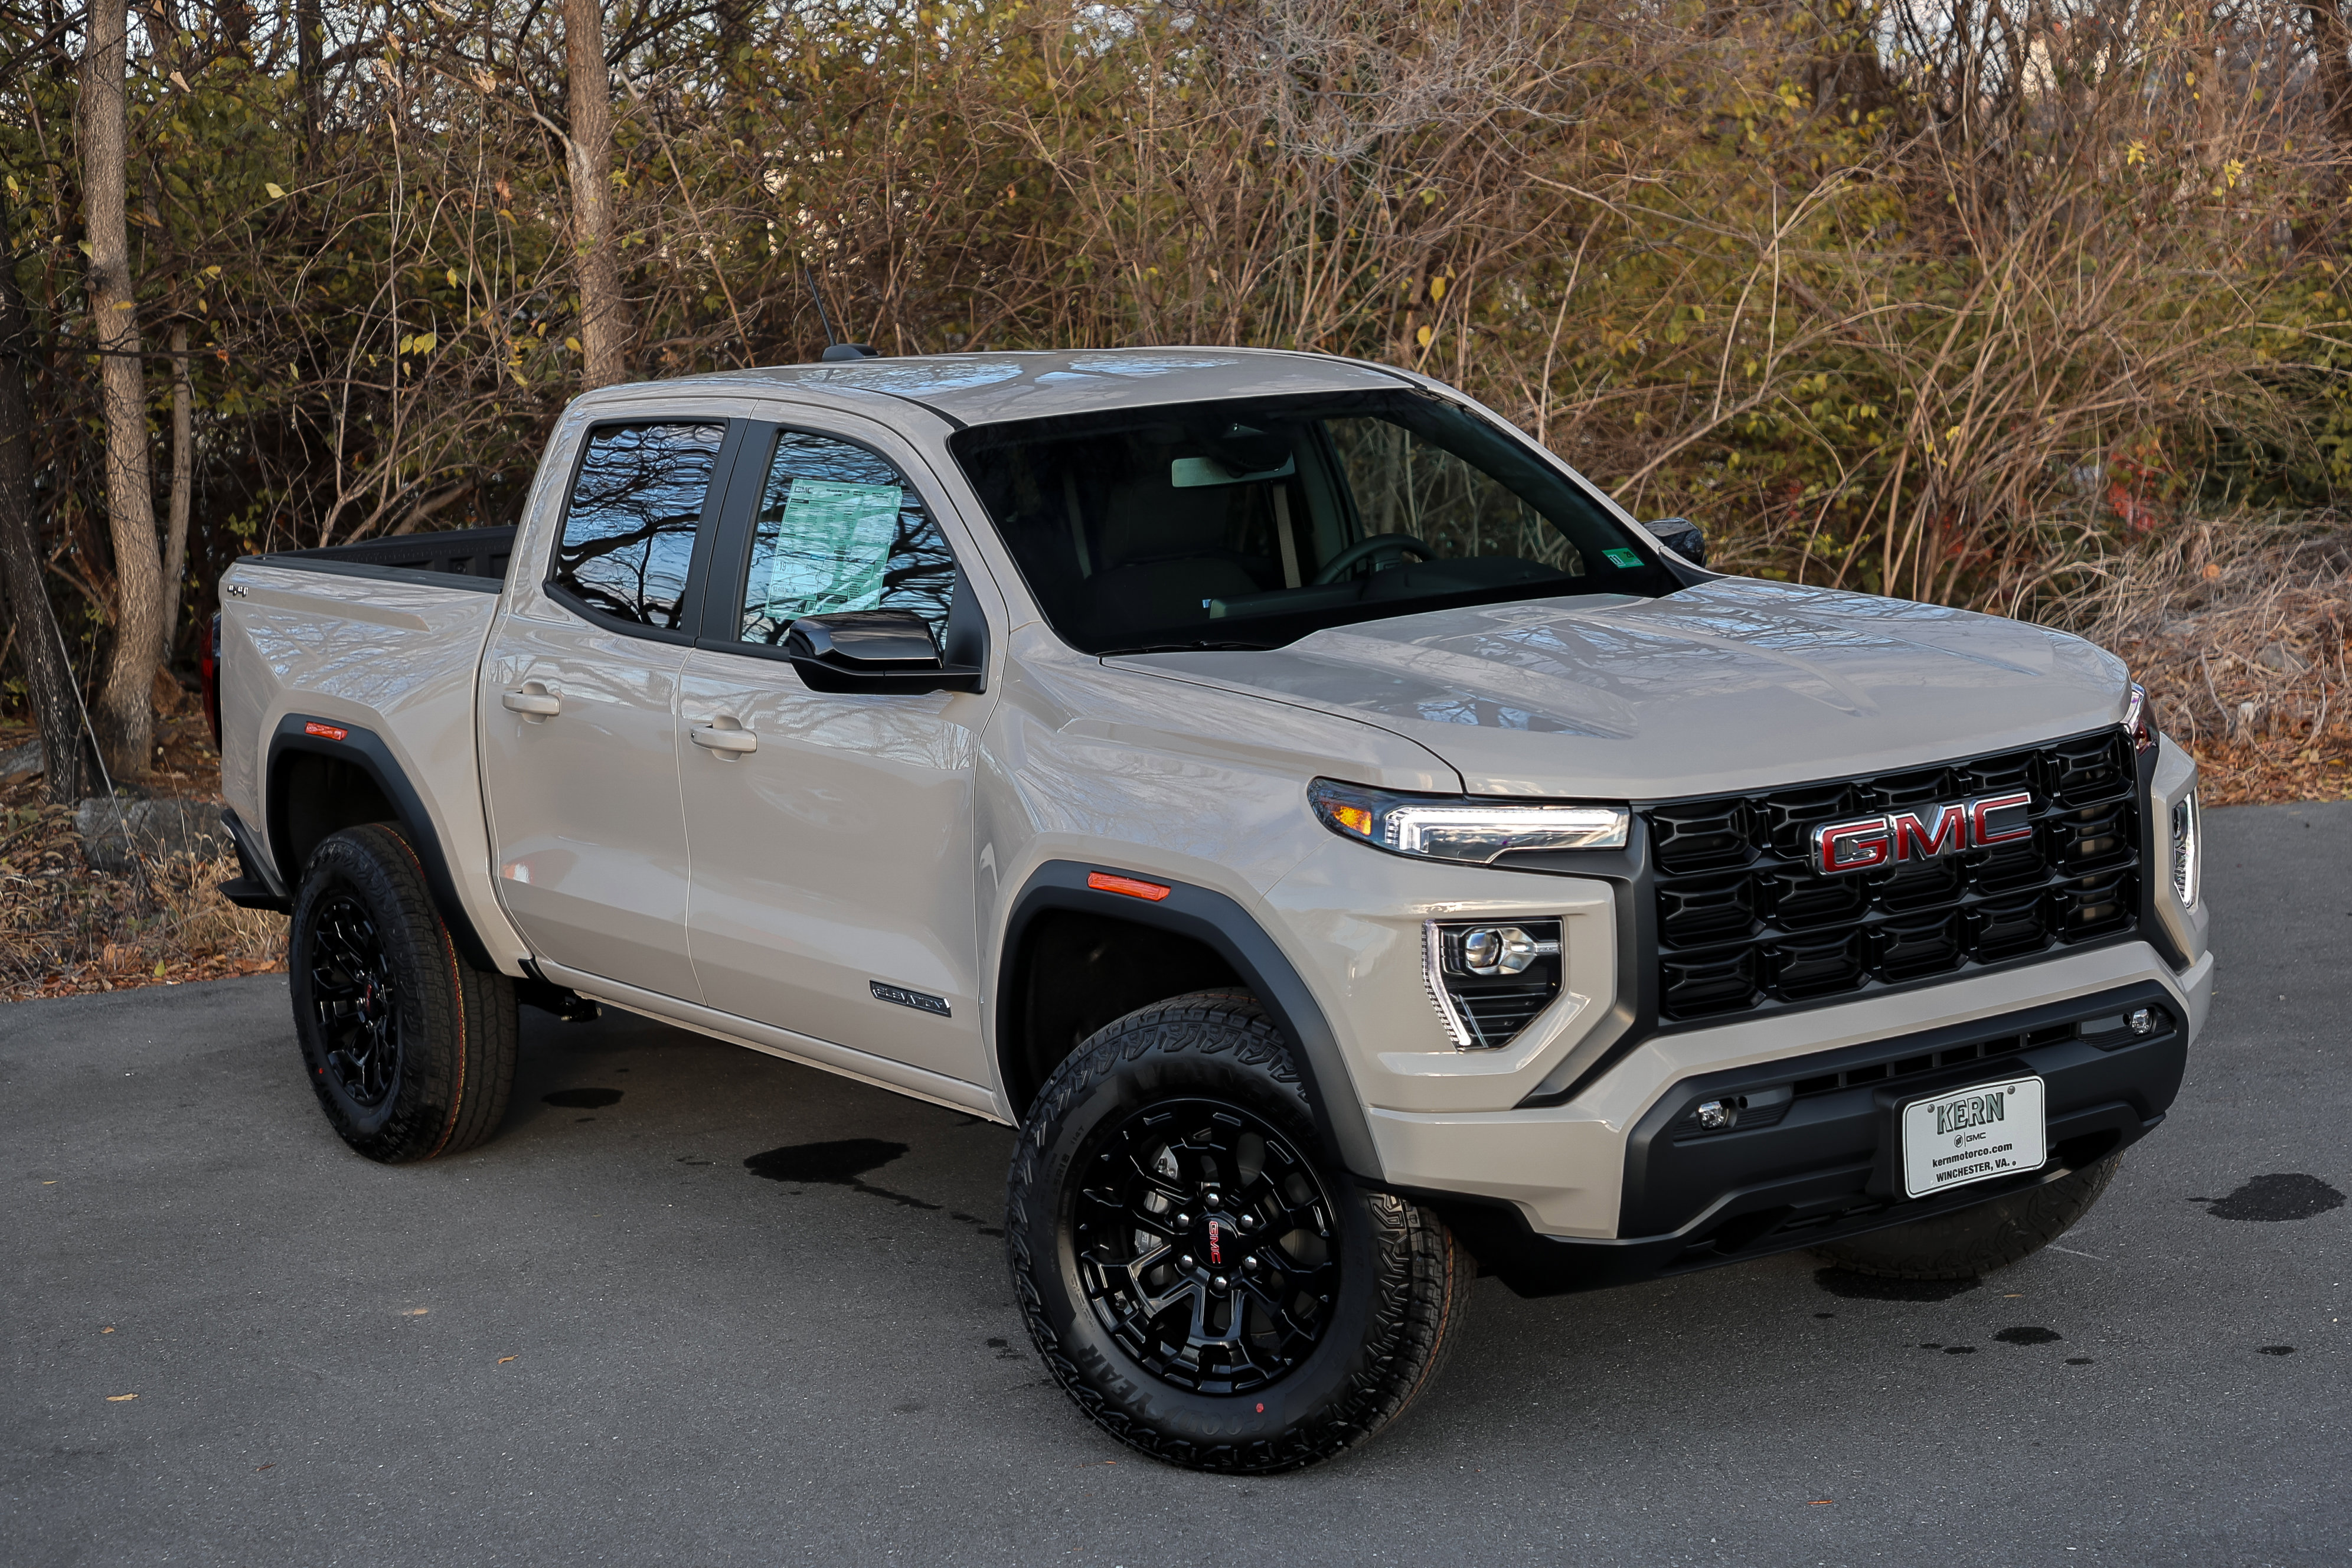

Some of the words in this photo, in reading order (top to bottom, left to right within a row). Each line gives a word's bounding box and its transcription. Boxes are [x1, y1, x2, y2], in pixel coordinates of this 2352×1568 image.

[1814, 792, 2033, 876] GMC
[1936, 1092, 2004, 1135] KERN
[1966, 1132, 1987, 1142] GMC
[1932, 1142, 2013, 1168] kernmotorco.com
[1936, 1162, 1994, 1182] WINCHESTER,
[1995, 1158, 2010, 1169] VA.
[1209, 1221, 1221, 1264] GMC
